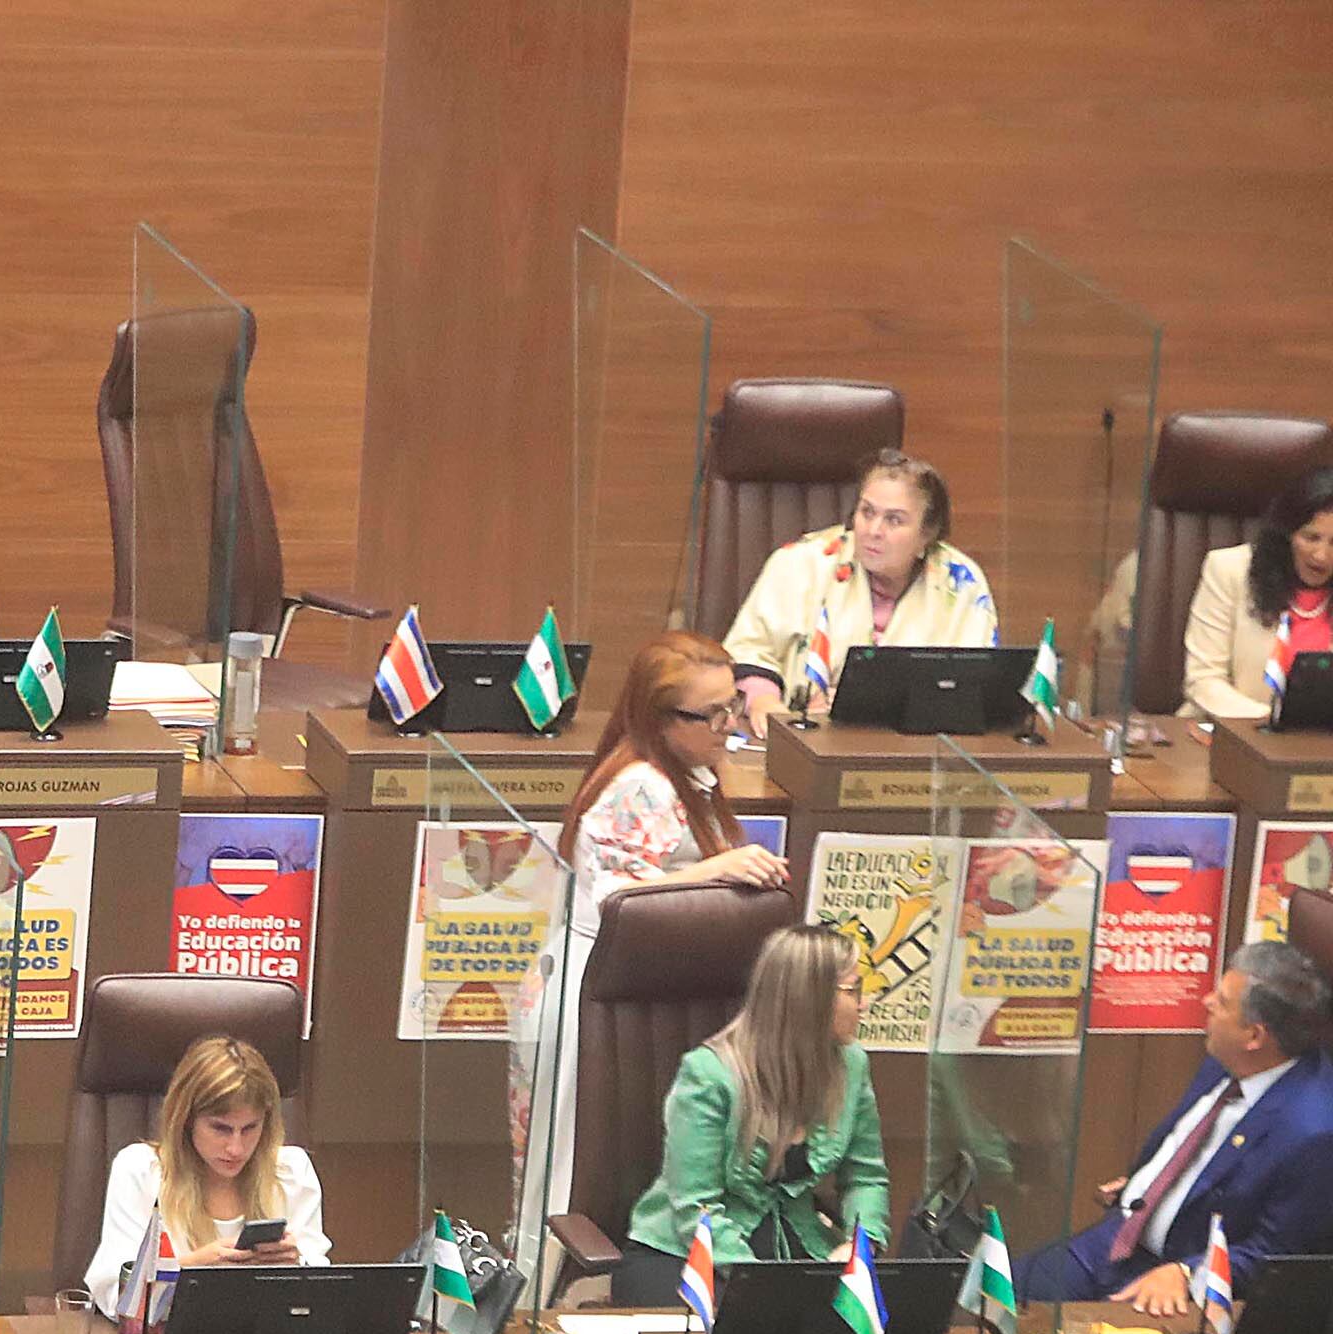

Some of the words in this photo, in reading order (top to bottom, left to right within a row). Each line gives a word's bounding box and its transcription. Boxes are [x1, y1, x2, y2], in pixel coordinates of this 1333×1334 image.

[530, 782, 564, 792] SOTO
[826, 875, 848, 889] NO
[178, 916, 201, 929] Yo
[205, 914, 284, 930] defiendo
[288, 918, 300, 927] la
[45, 938, 68, 951] ES
[179, 929, 300, 950] Educación
[178, 951, 298, 977] Pública
